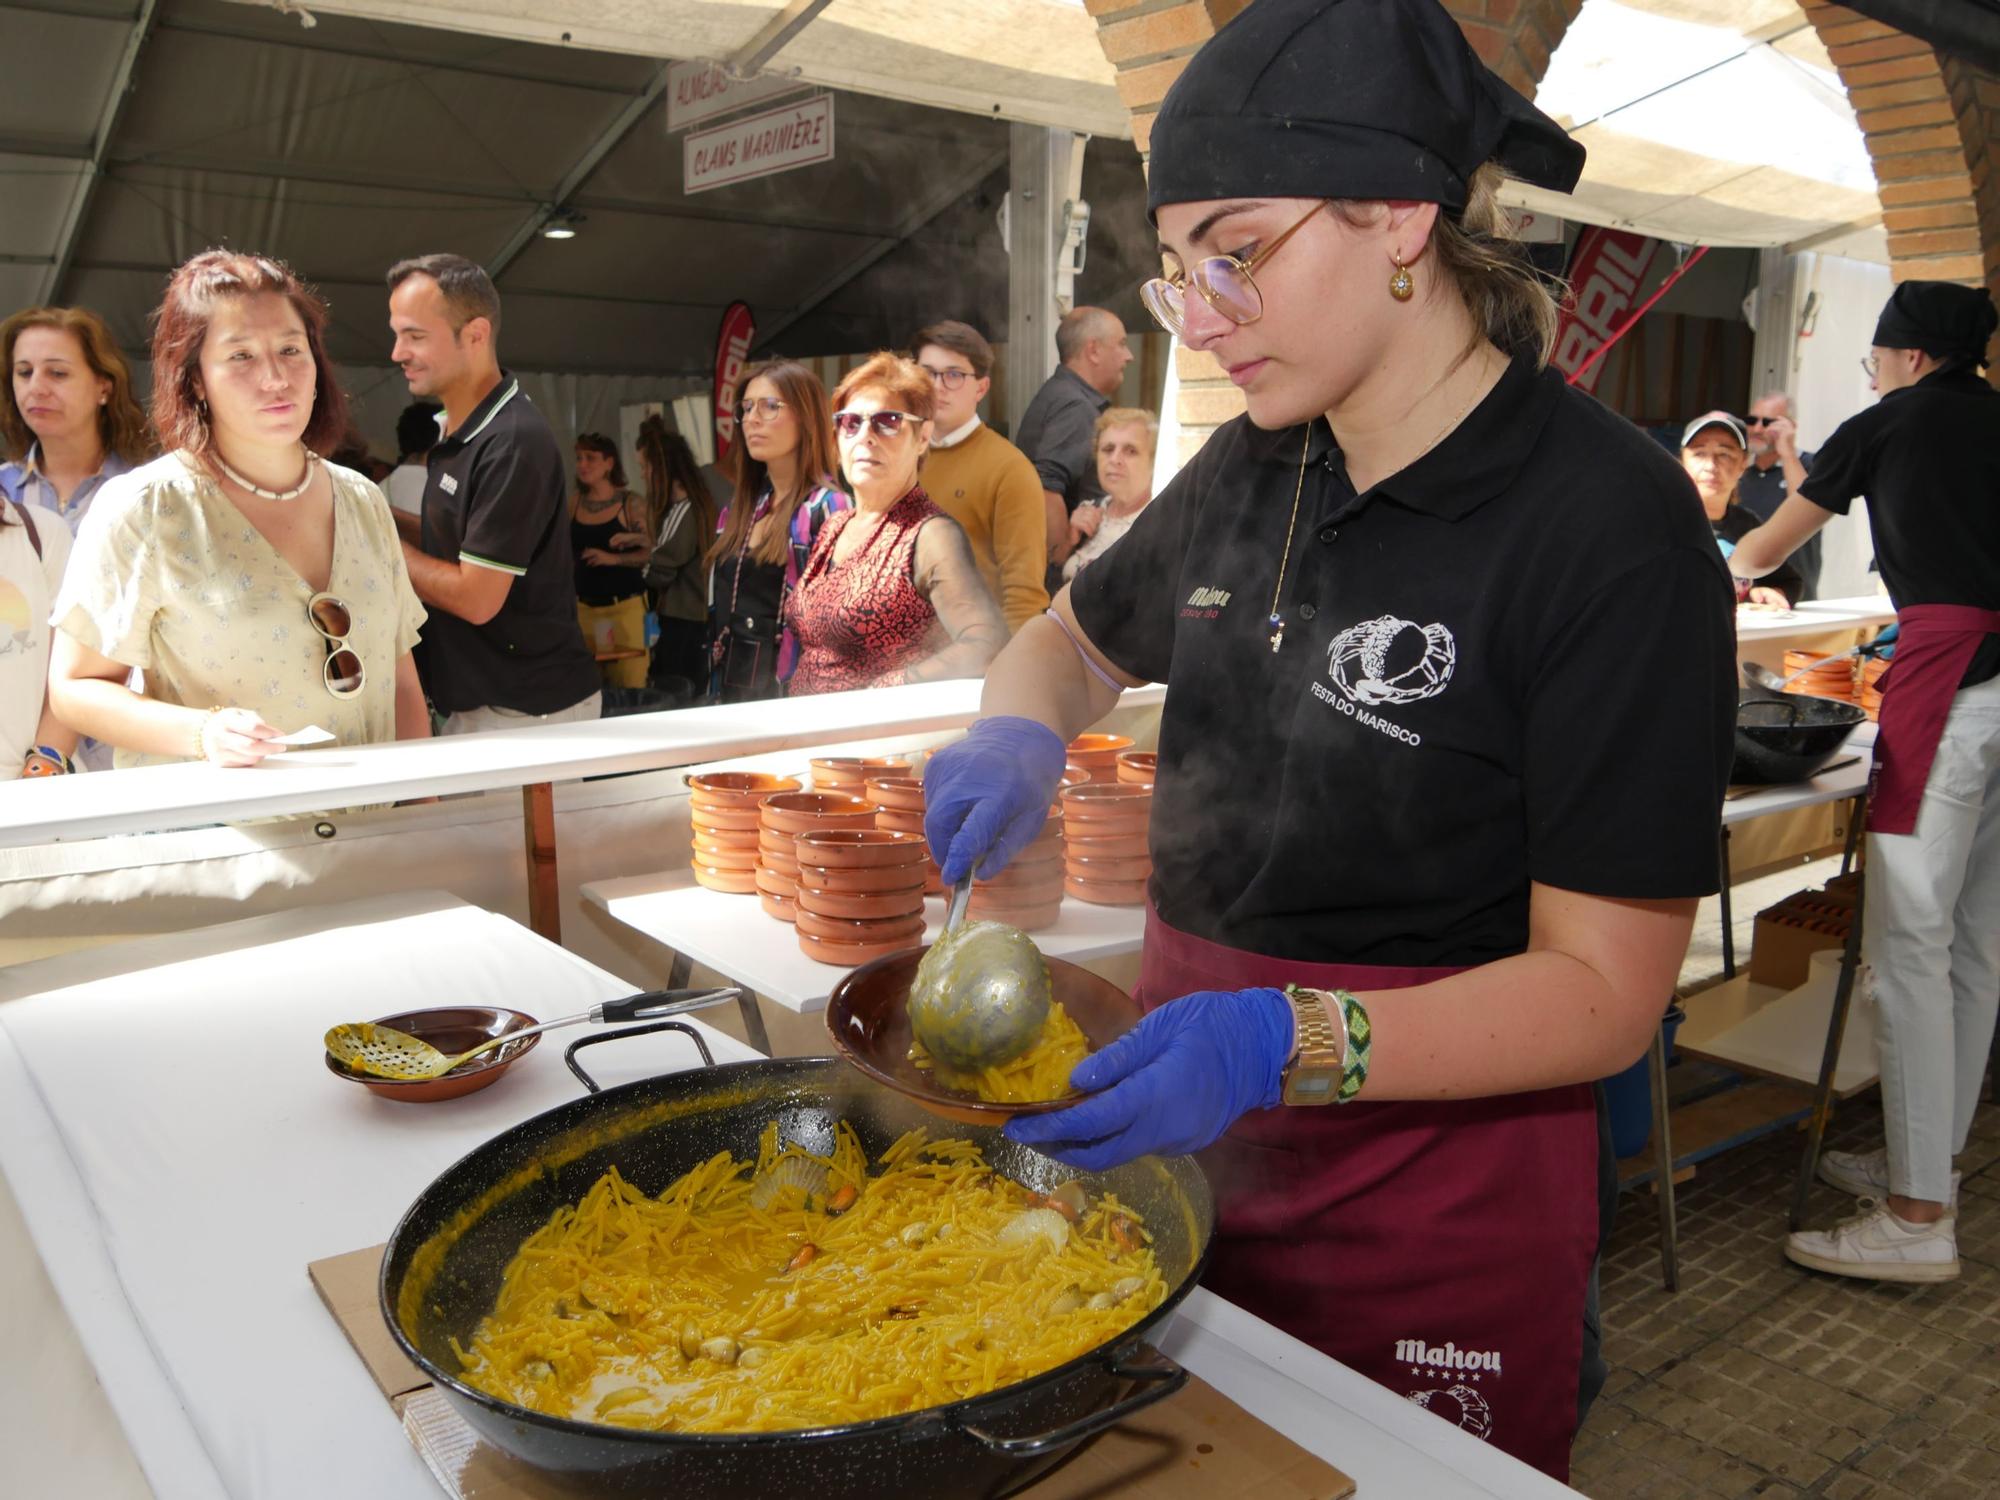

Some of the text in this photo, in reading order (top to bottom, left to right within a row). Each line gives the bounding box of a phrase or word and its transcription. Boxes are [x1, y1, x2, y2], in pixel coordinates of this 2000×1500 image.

[694, 112, 825, 175] CLAMS MARINIÈRE
[1556, 238, 1659, 391] BRIL
[1310, 681, 1421, 747] FESTA DO MARISCO
[1394, 1339, 1502, 1371] Mahou
